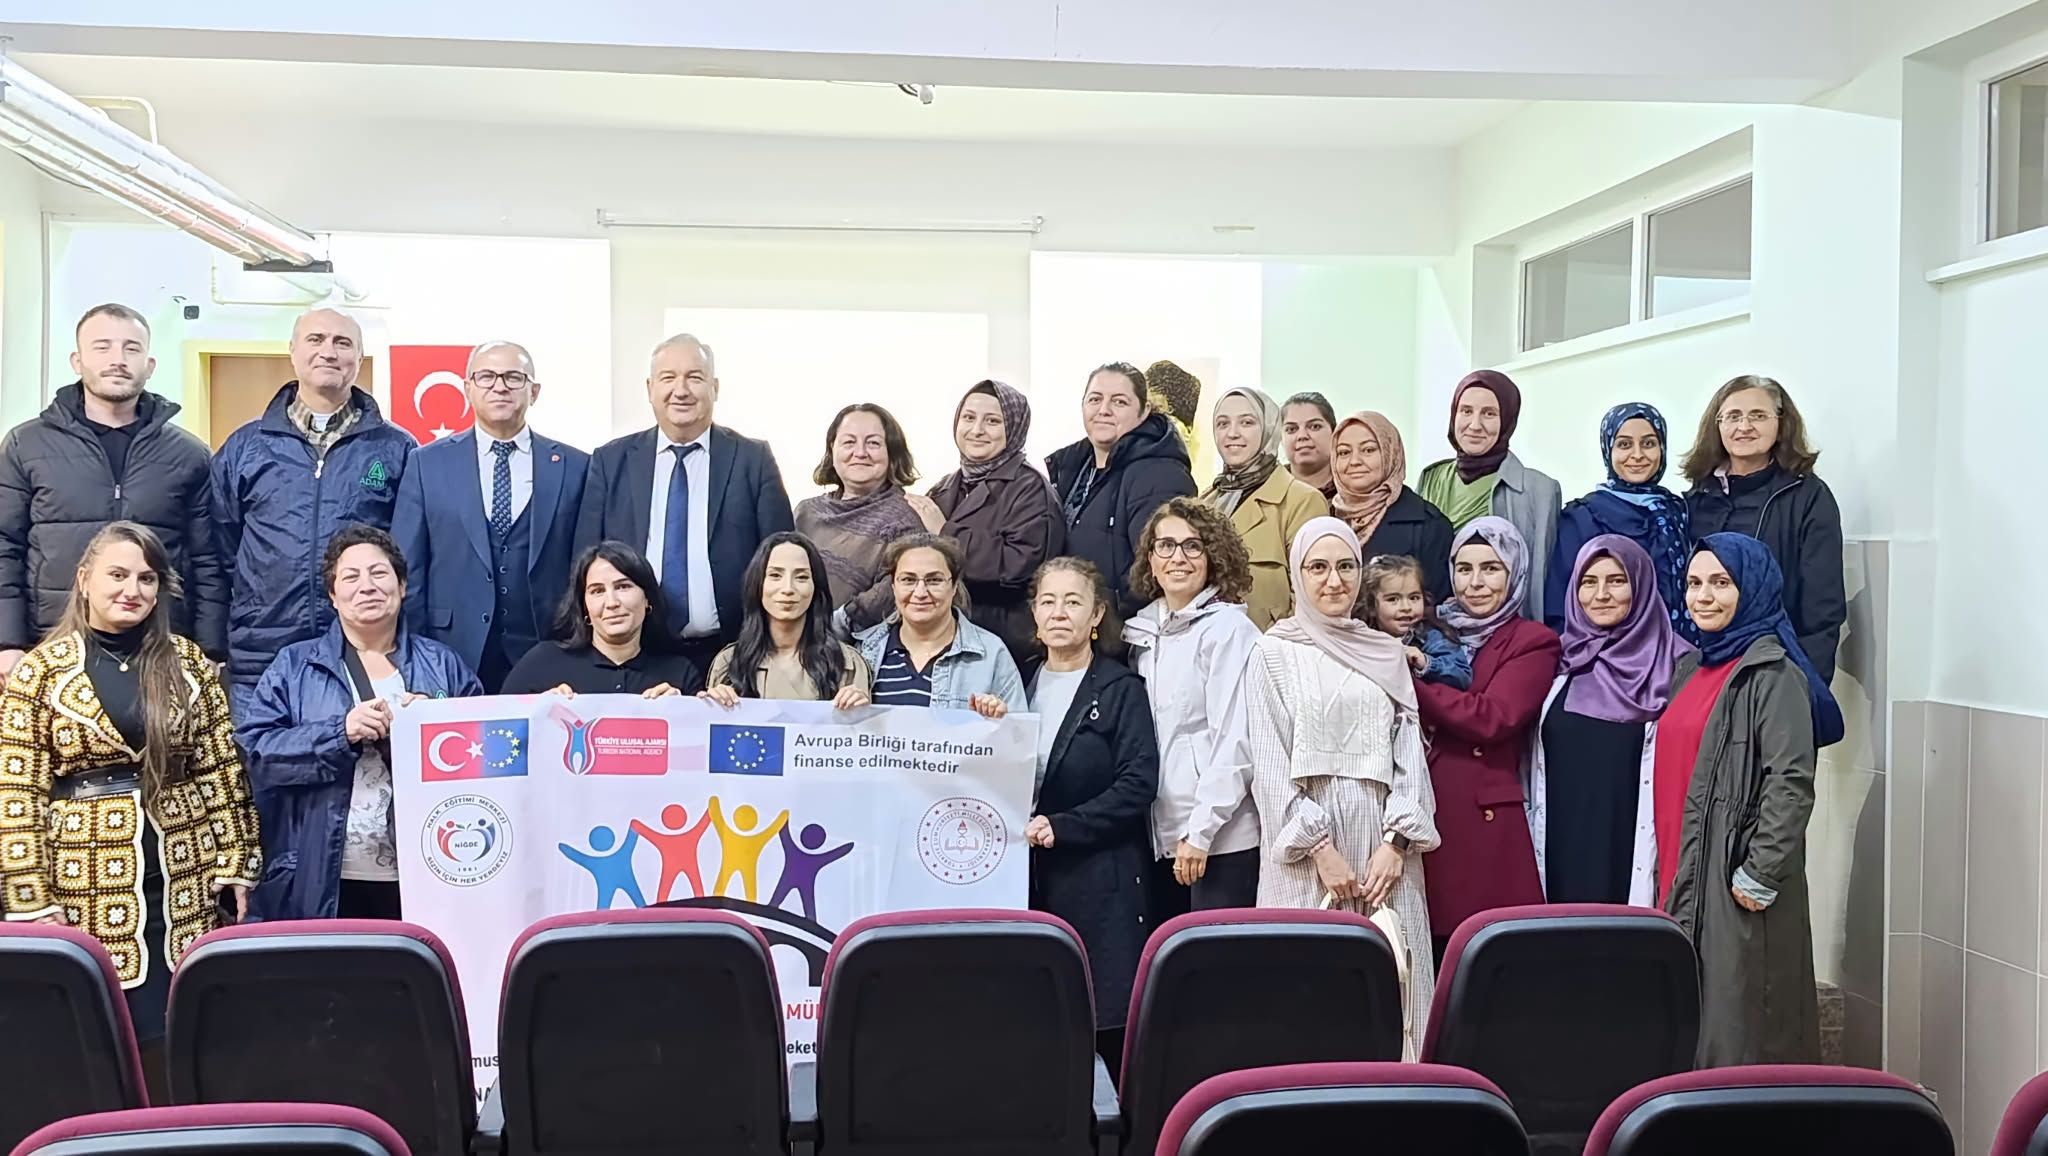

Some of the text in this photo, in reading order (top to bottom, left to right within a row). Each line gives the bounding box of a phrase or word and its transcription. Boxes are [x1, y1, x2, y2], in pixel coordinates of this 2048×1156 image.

[794, 734, 994, 756] Avrupa Birliği tarafından
[794, 754, 960, 774] finanse edilmektedir
[427, 797, 508, 828] HALK EĞİTİMİ MERKEZİ
[479, 851, 508, 880] YERDEYİZ
